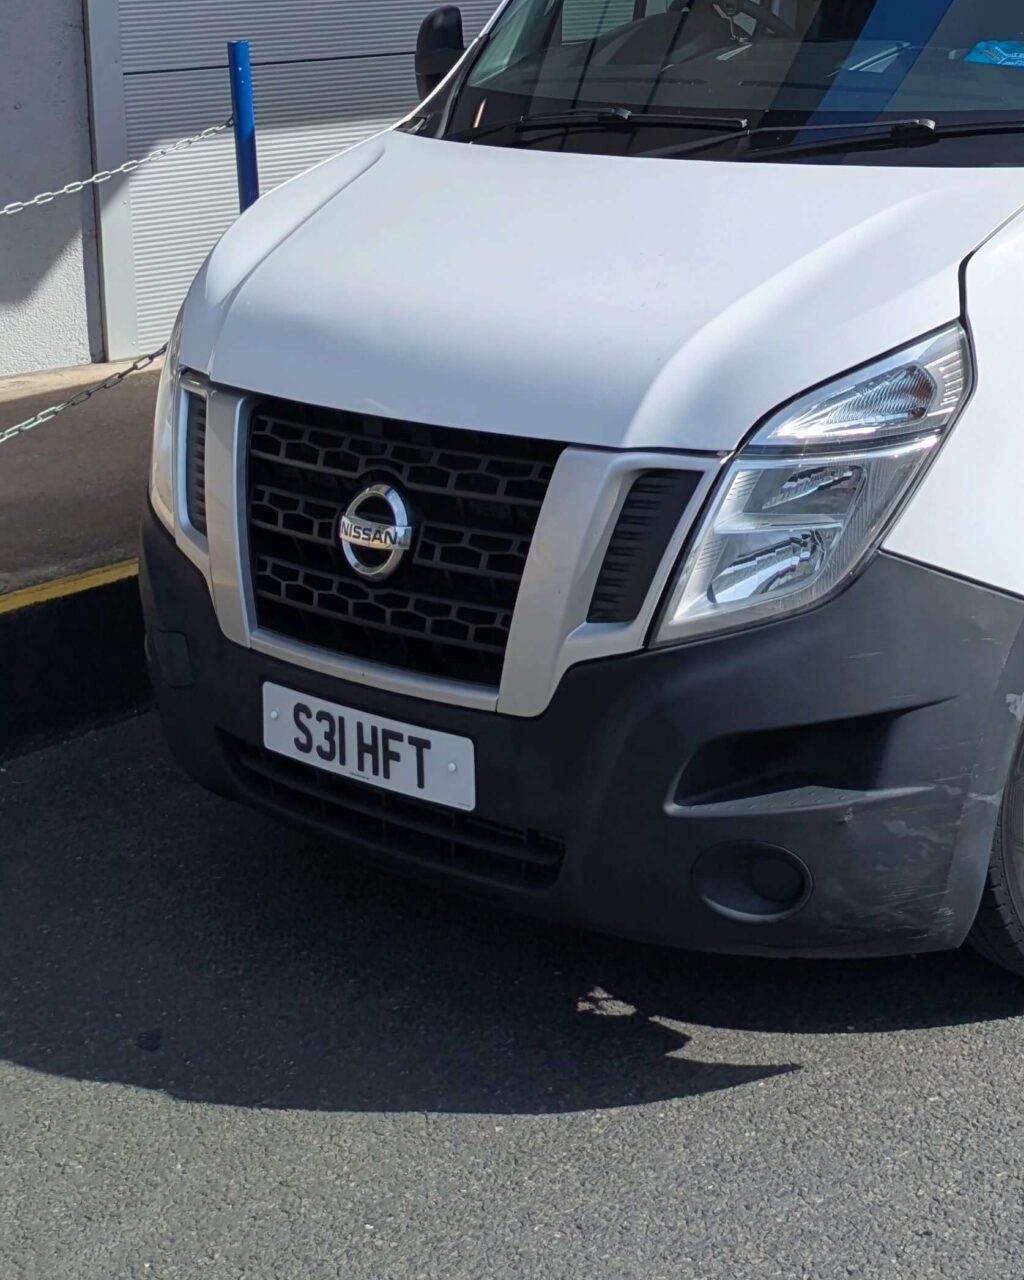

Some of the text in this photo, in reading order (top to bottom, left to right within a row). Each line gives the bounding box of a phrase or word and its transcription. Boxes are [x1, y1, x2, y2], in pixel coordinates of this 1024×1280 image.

[341, 521, 398, 546] NISSAN
[293, 703, 431, 789] S31 HFT
